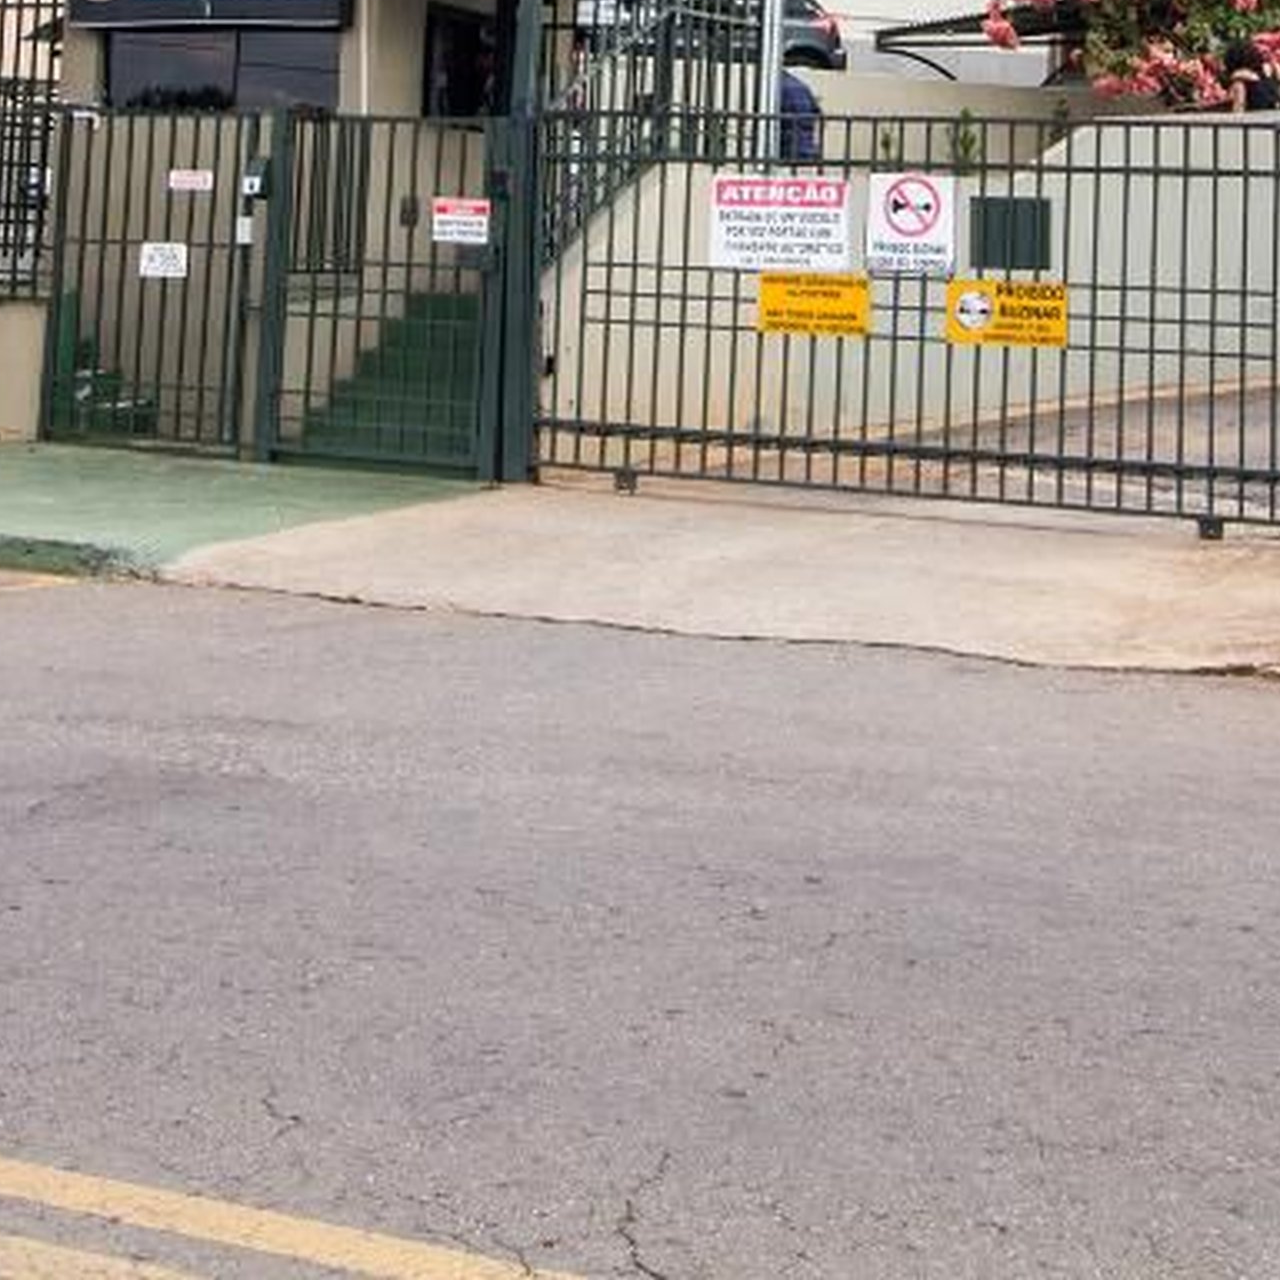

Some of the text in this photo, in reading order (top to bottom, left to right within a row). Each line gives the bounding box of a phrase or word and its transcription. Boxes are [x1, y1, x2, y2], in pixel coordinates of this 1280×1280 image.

[722, 181, 838, 203] ATENÇÃO
[996, 283, 1064, 301] PROIBIDO
[999, 303, 1061, 320] BUZINAR
